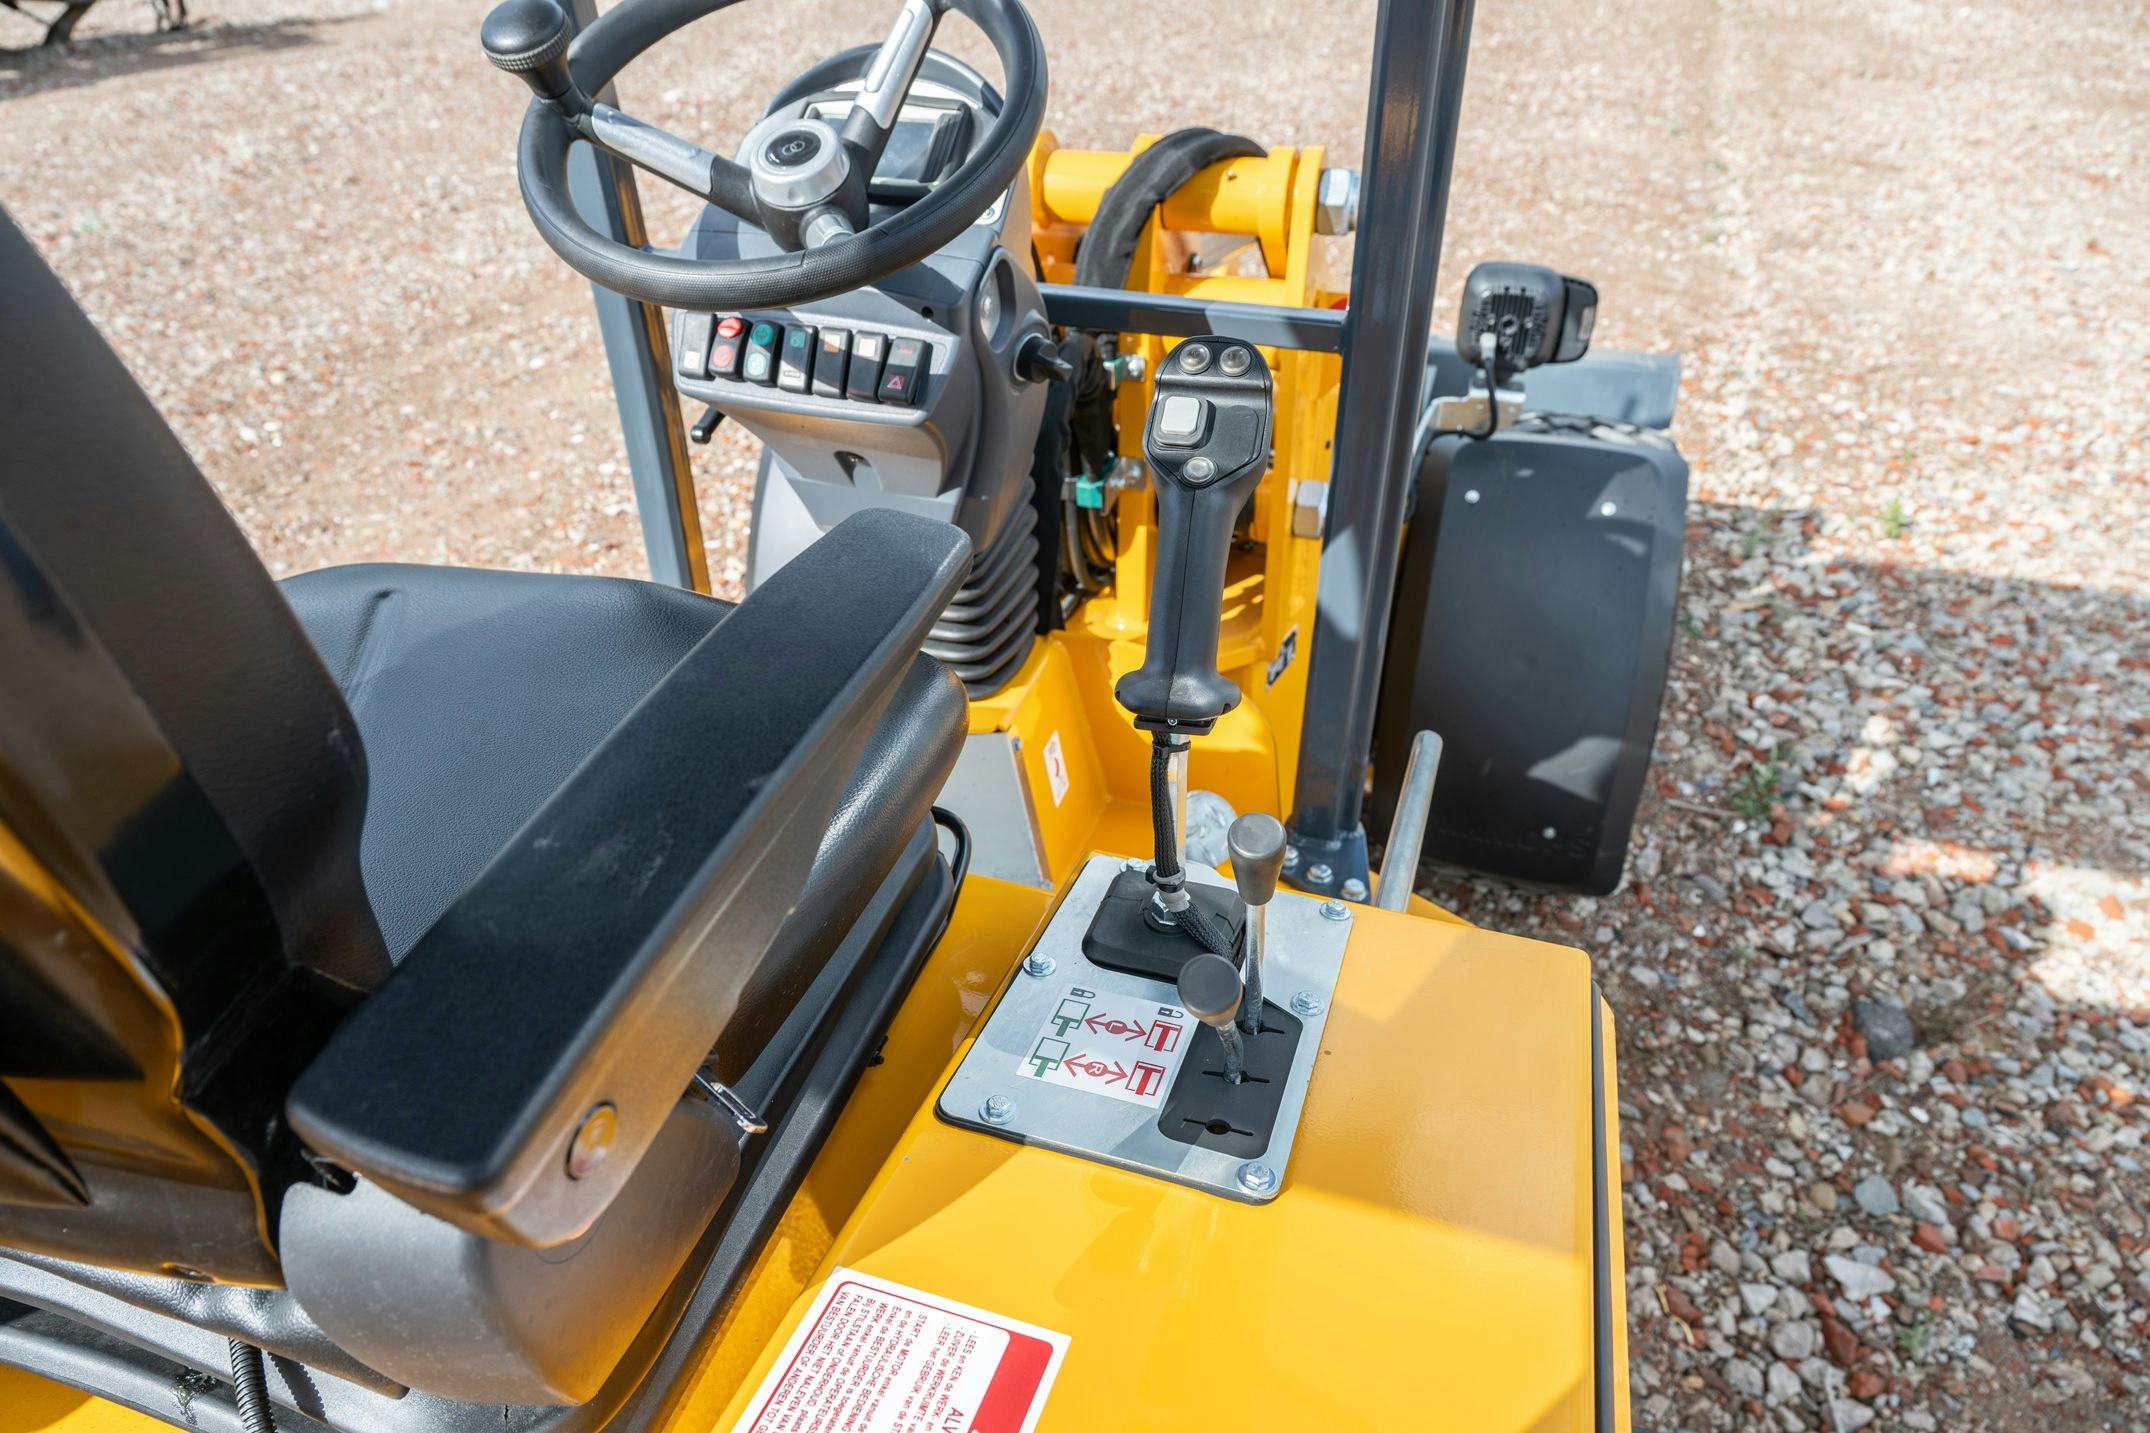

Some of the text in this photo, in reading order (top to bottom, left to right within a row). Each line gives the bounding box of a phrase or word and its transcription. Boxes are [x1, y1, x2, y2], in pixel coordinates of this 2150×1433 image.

[1109, 1022, 1122, 1031] L
[1089, 1063, 1104, 1074] R
[835, 1292, 850, 1306] VAN
[862, 1298, 876, 1307] Bij
[871, 1302, 888, 1324] WERK
[885, 1306, 902, 1326] Enkel
[905, 1310, 912, 1318] en
[806, 1306, 841, 1355] BESTUURDER
[831, 1318, 849, 1340] DOOR
[841, 1309, 870, 1348] STILSTAAN
[880, 1326, 889, 1335] de
[898, 1320, 907, 1328] de
[859, 1324, 874, 1344] enkel
[936, 1326, 950, 1346] LEER
[823, 1340, 834, 1356] HET
[948, 1330, 965, 1357] ZUIVER
[963, 1335, 977, 1354] LEES
[800, 1356, 810, 1367] OF
[846, 1344, 862, 1366] vanuit
[850, 1336, 885, 1387] BESTUURDER
[940, 1358, 949, 1367] de
[959, 1355, 966, 1364] en
[812, 1356, 826, 1374] NIET
[840, 1367, 850, 1376] de
[949, 1366, 962, 1381] KEN
[857, 1315, 927, 1433] START de MOTOR enkel vanuit de
[911, 1360, 935, 1394] GEBRUIK
[774, 1367, 802, 1406] ANDEREN
[787, 1375, 815, 1412] NALEVEN
[913, 1369, 945, 1421] WERKRUIMTE
[944, 1383, 953, 1392] de
[841, 1388, 872, 1432] BEDIENING
[904, 1396, 913, 1409] van
[765, 1408, 780, 1424] TOT
[776, 1414, 791, 1430] VAN
[791, 1408, 809, 1433] plaats
[897, 1411, 907, 1420] de
[926, 1422, 934, 1431] en
